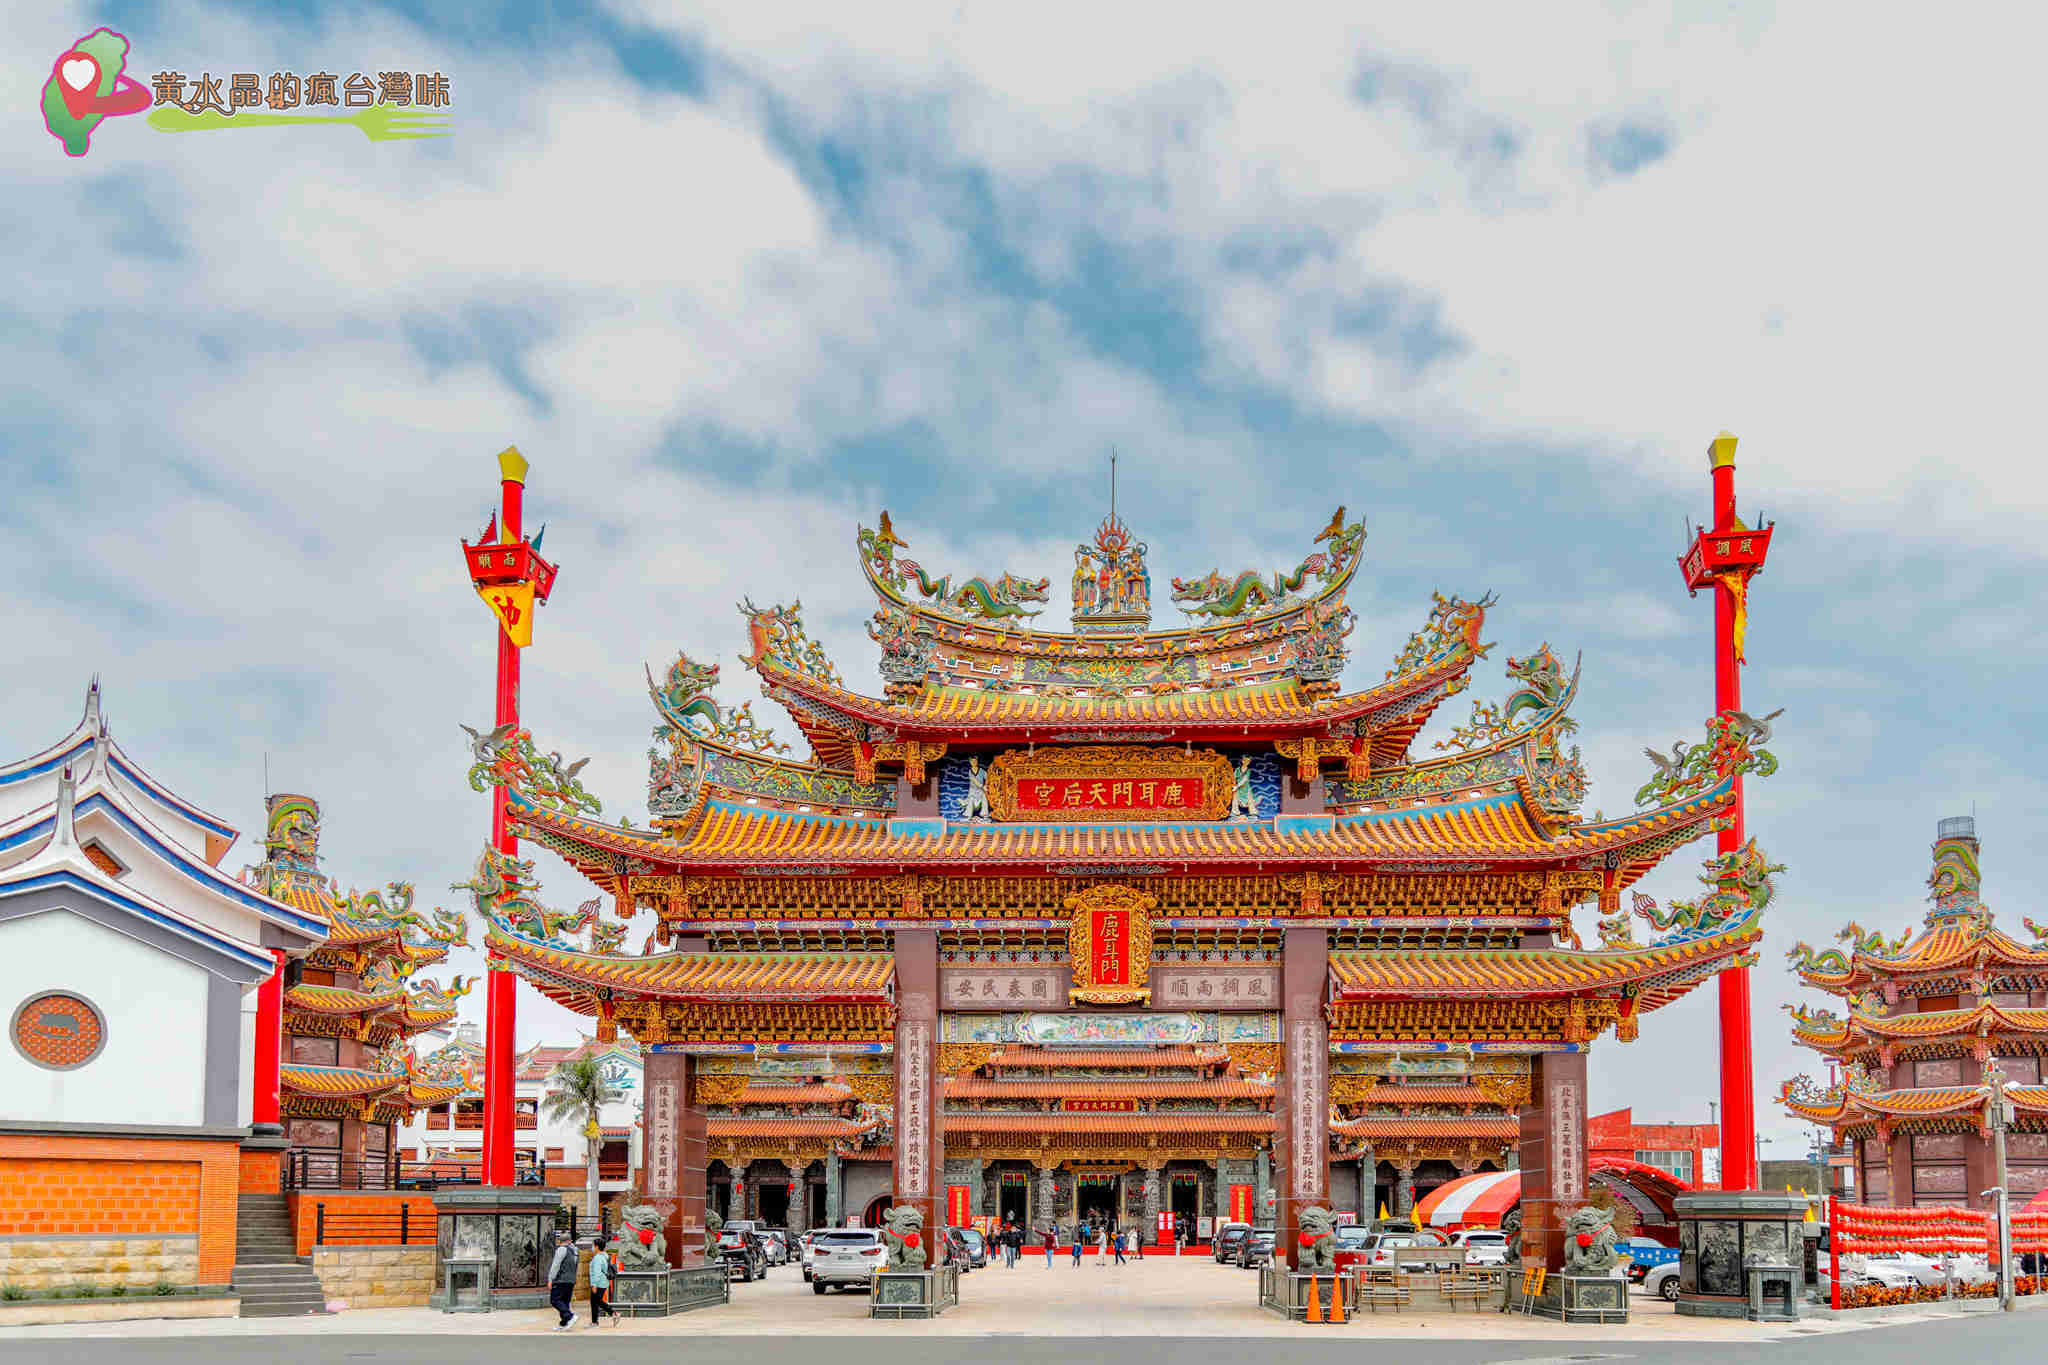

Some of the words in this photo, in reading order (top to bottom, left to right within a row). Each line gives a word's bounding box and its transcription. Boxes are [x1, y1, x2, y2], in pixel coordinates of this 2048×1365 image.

[1034, 781, 1185, 807] 鹿耳門天后宮
